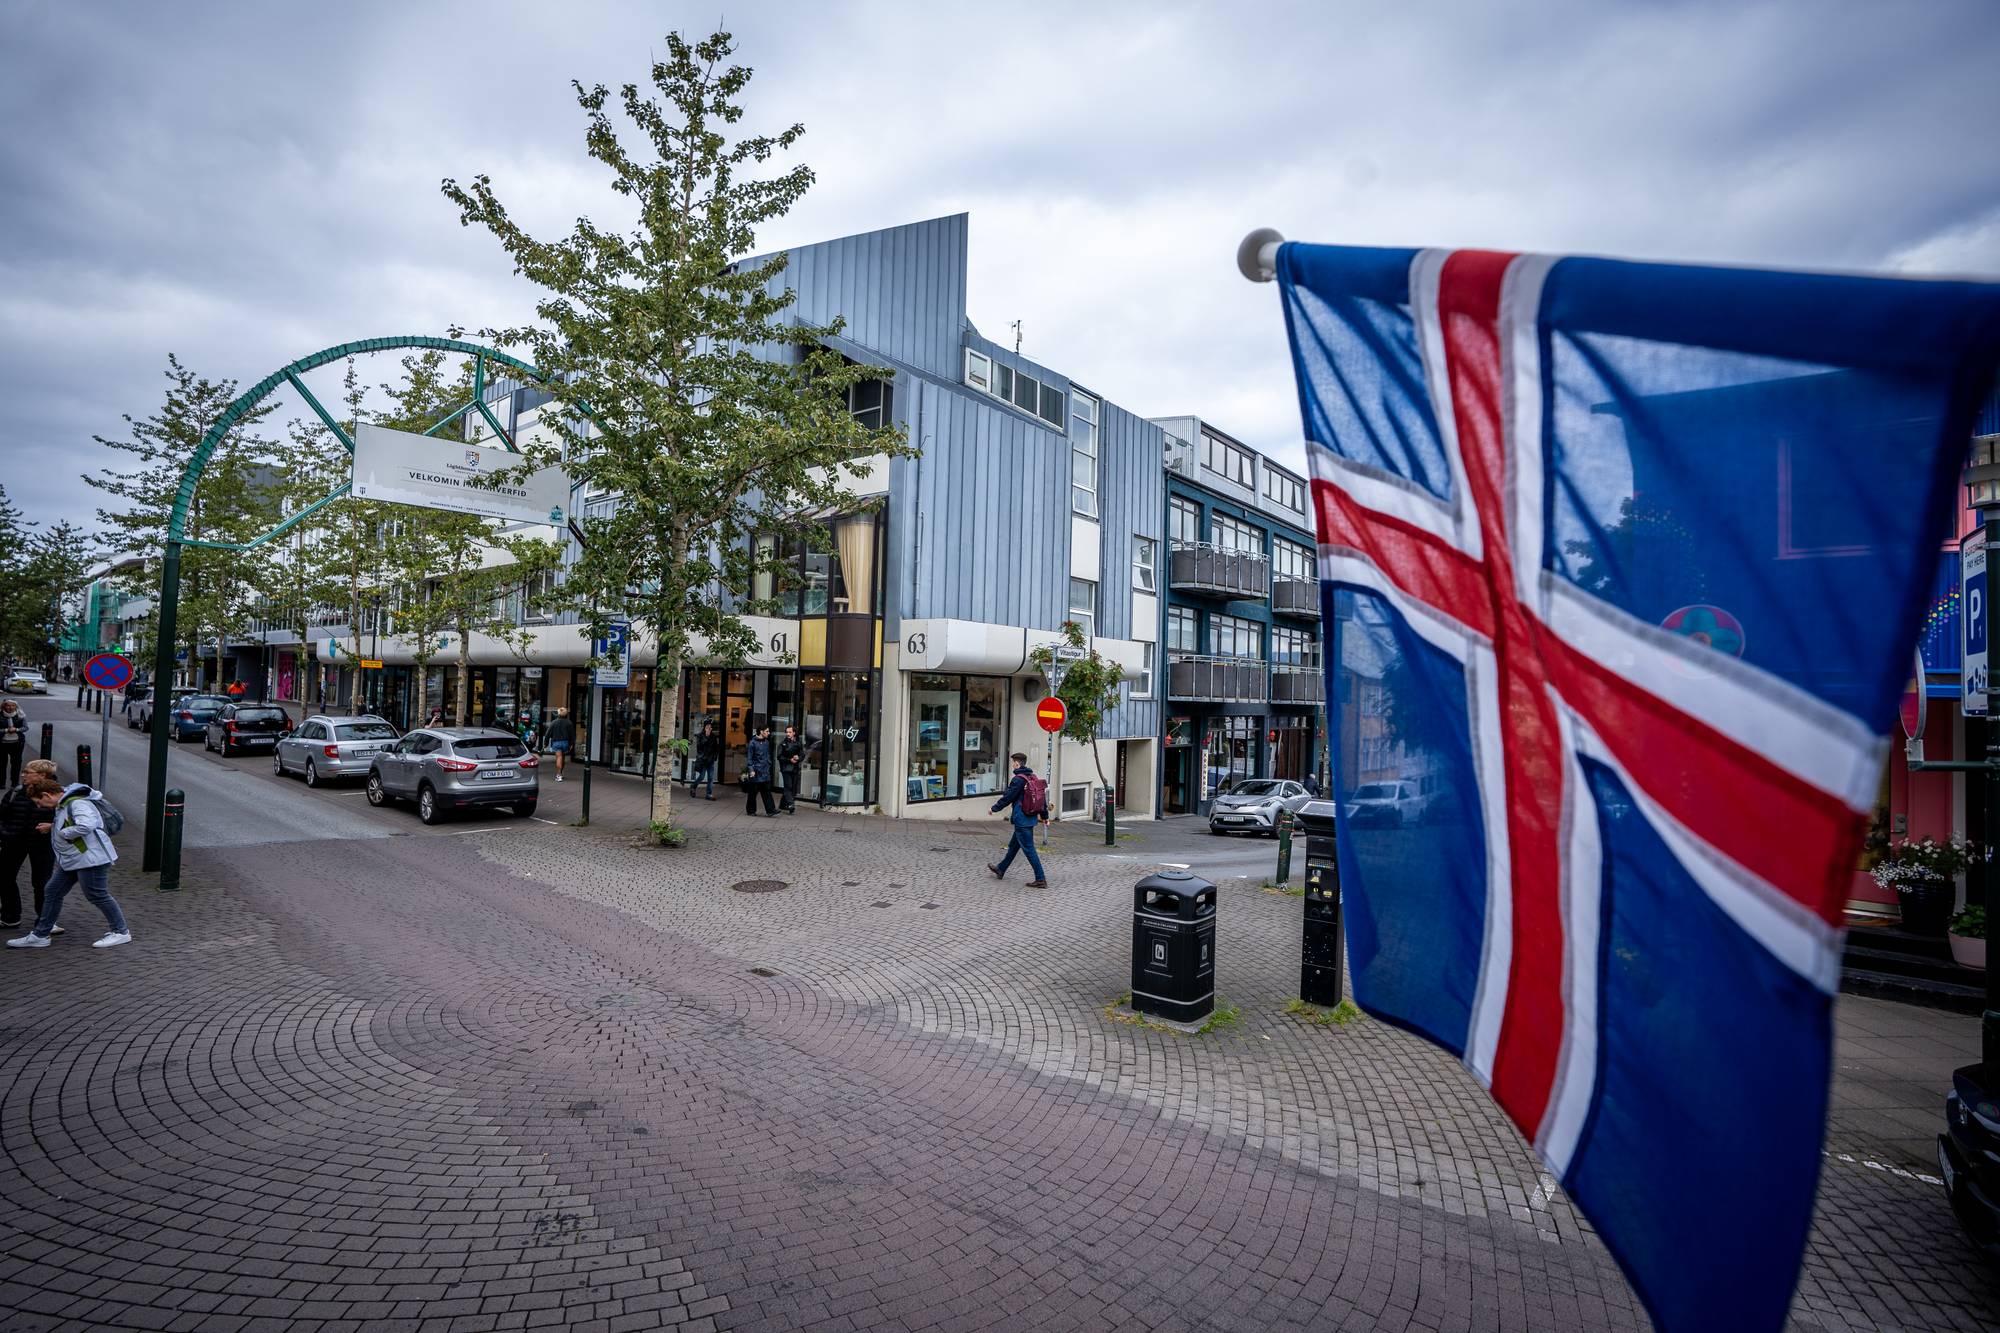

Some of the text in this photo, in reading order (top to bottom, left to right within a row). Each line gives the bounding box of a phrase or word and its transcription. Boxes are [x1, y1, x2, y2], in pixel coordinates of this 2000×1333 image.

[409, 471, 460, 486] VELKOMIN
[467, 480, 526, 497] TAHVERFIÐ
[1970, 588, 1981, 640] P
[607, 629, 620, 648] P
[770, 632, 788, 653] 61
[907, 632, 926, 654] 63
